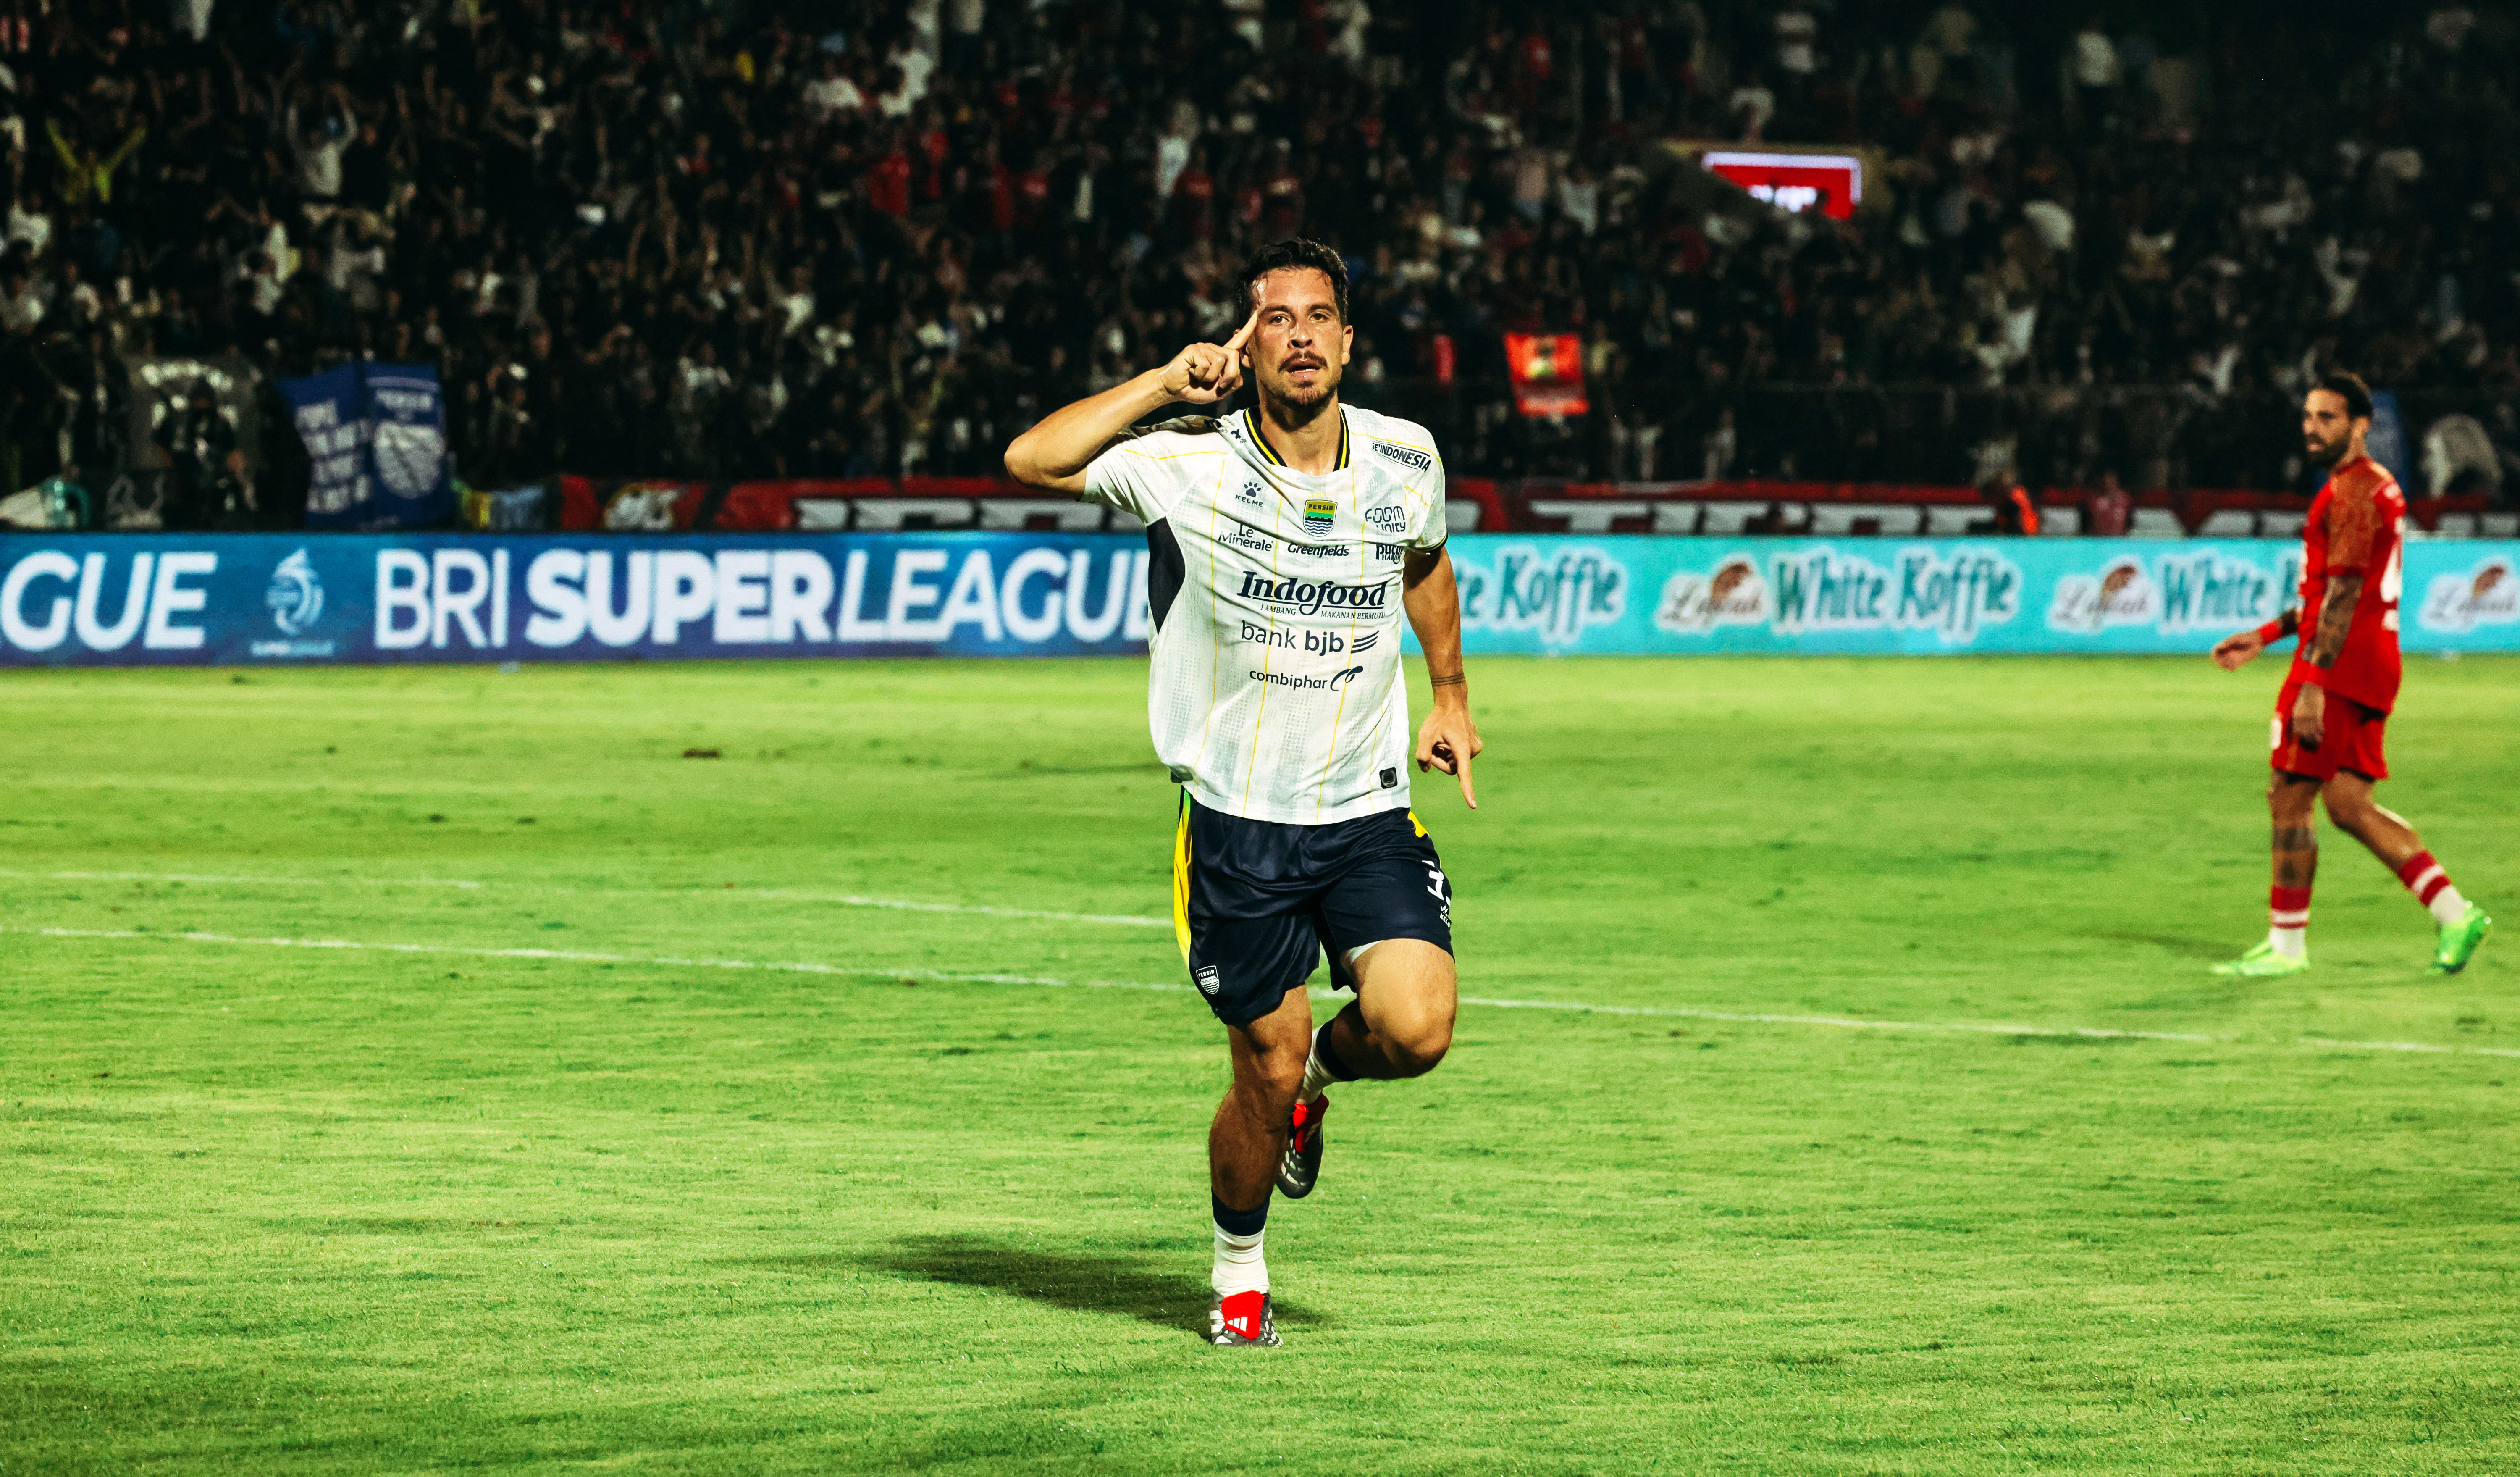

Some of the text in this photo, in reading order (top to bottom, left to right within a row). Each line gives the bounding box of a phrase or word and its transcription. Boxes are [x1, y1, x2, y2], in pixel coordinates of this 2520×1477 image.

[1372, 442, 1431, 473] SE'INDONESIA
[1235, 494, 1263, 507] KELME
[1239, 523, 1254, 538] Le
[1218, 531, 1272, 552] Minerale
[1287, 542, 1349, 558] Greenfields
[375, 549, 509, 648] BRI
[524, 547, 835, 647] SUPER
[1237, 571, 1388, 615] Indofood
[1260, 604, 1296, 615] LAMBANG
[1321, 610, 1356, 619] MAKANAN
[1242, 620, 1344, 656] bank bjb
[1250, 670, 1328, 690] combiphar
[1440, 913, 1451, 930] KELM
[1198, 969, 1215, 978] PERSIB
